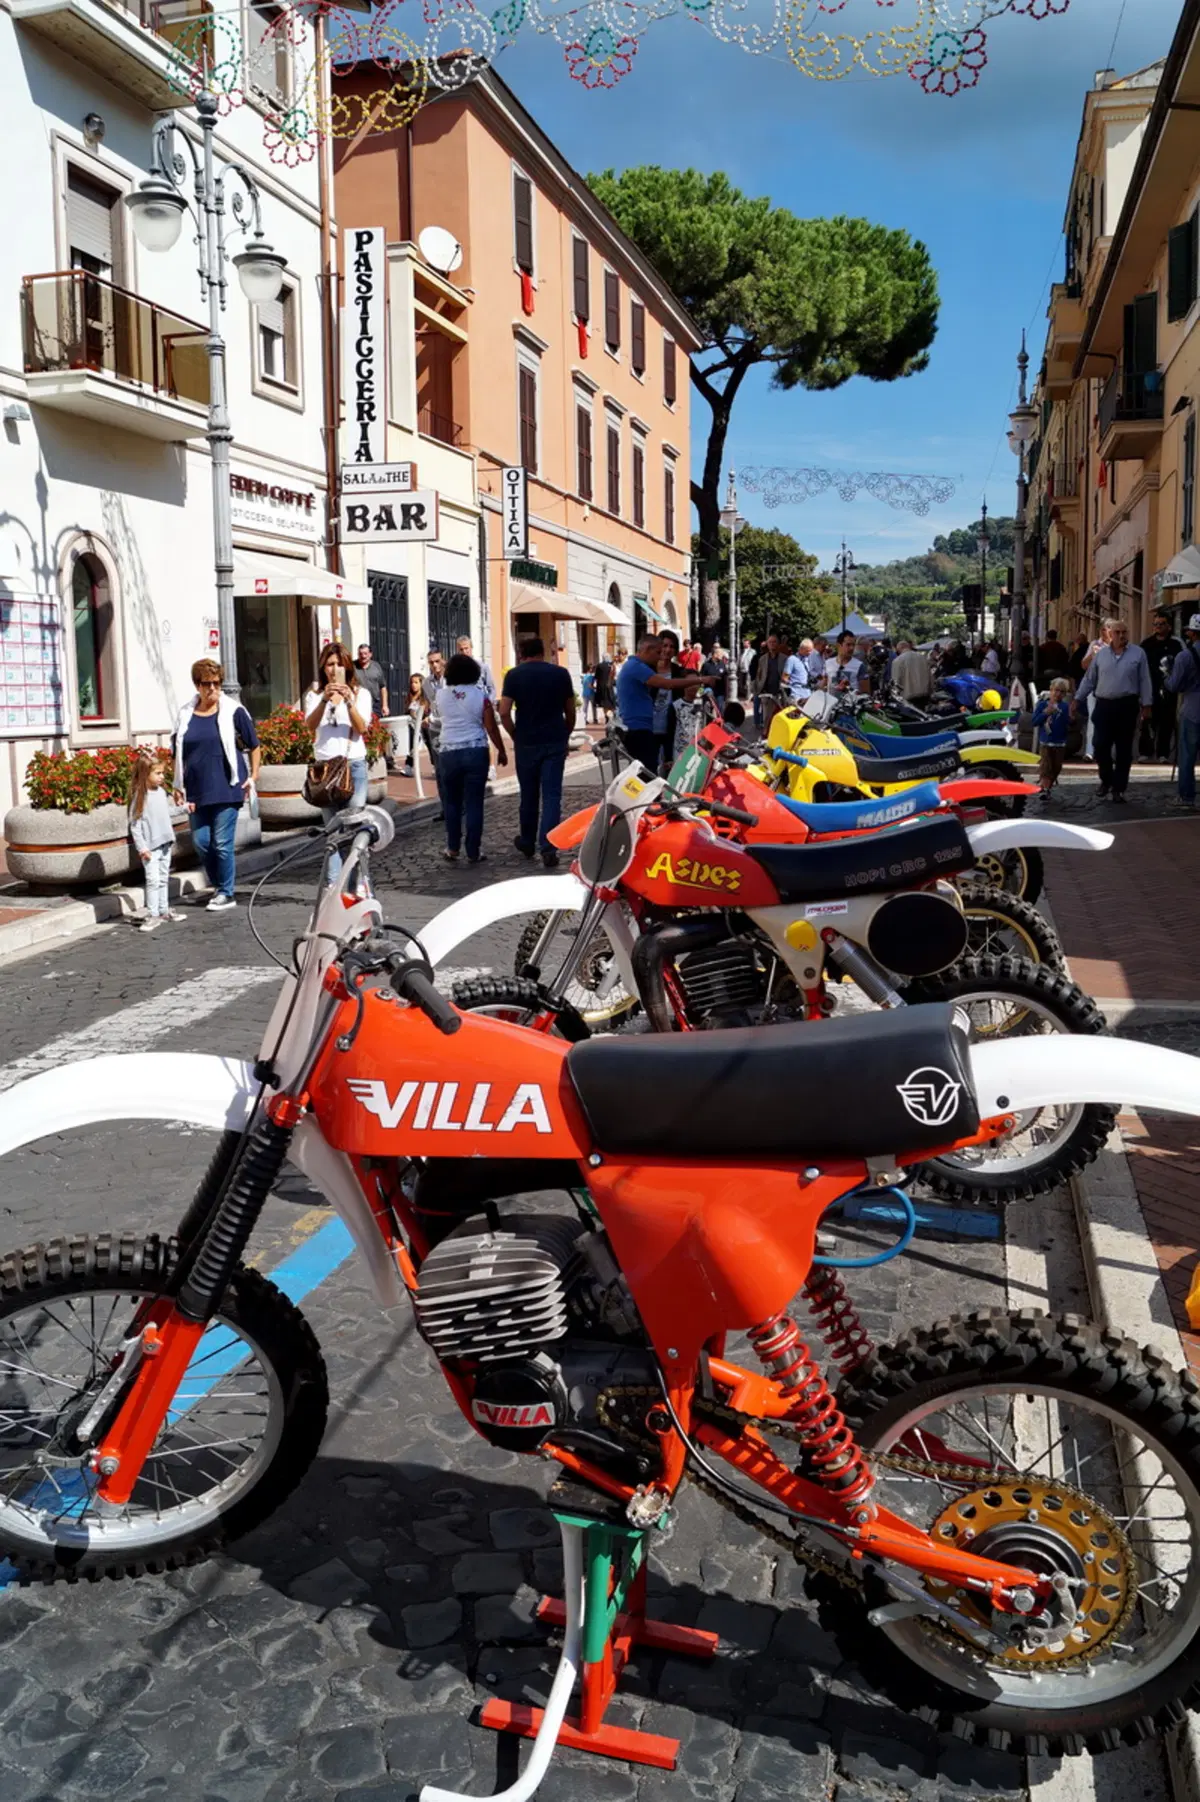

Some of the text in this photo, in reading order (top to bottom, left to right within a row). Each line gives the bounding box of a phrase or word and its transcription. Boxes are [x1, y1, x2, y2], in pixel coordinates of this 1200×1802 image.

[353, 230, 376, 463] PASTICCERIA
[229, 473, 268, 496] EDEN
[343, 473, 377, 485] SALA
[386, 471, 409, 483] THE
[345, 502, 428, 533] BAR
[506, 469, 520, 548] OTTICA
[346, 1078, 553, 1134] VILLA
[476, 1402, 552, 1427] VILLA
